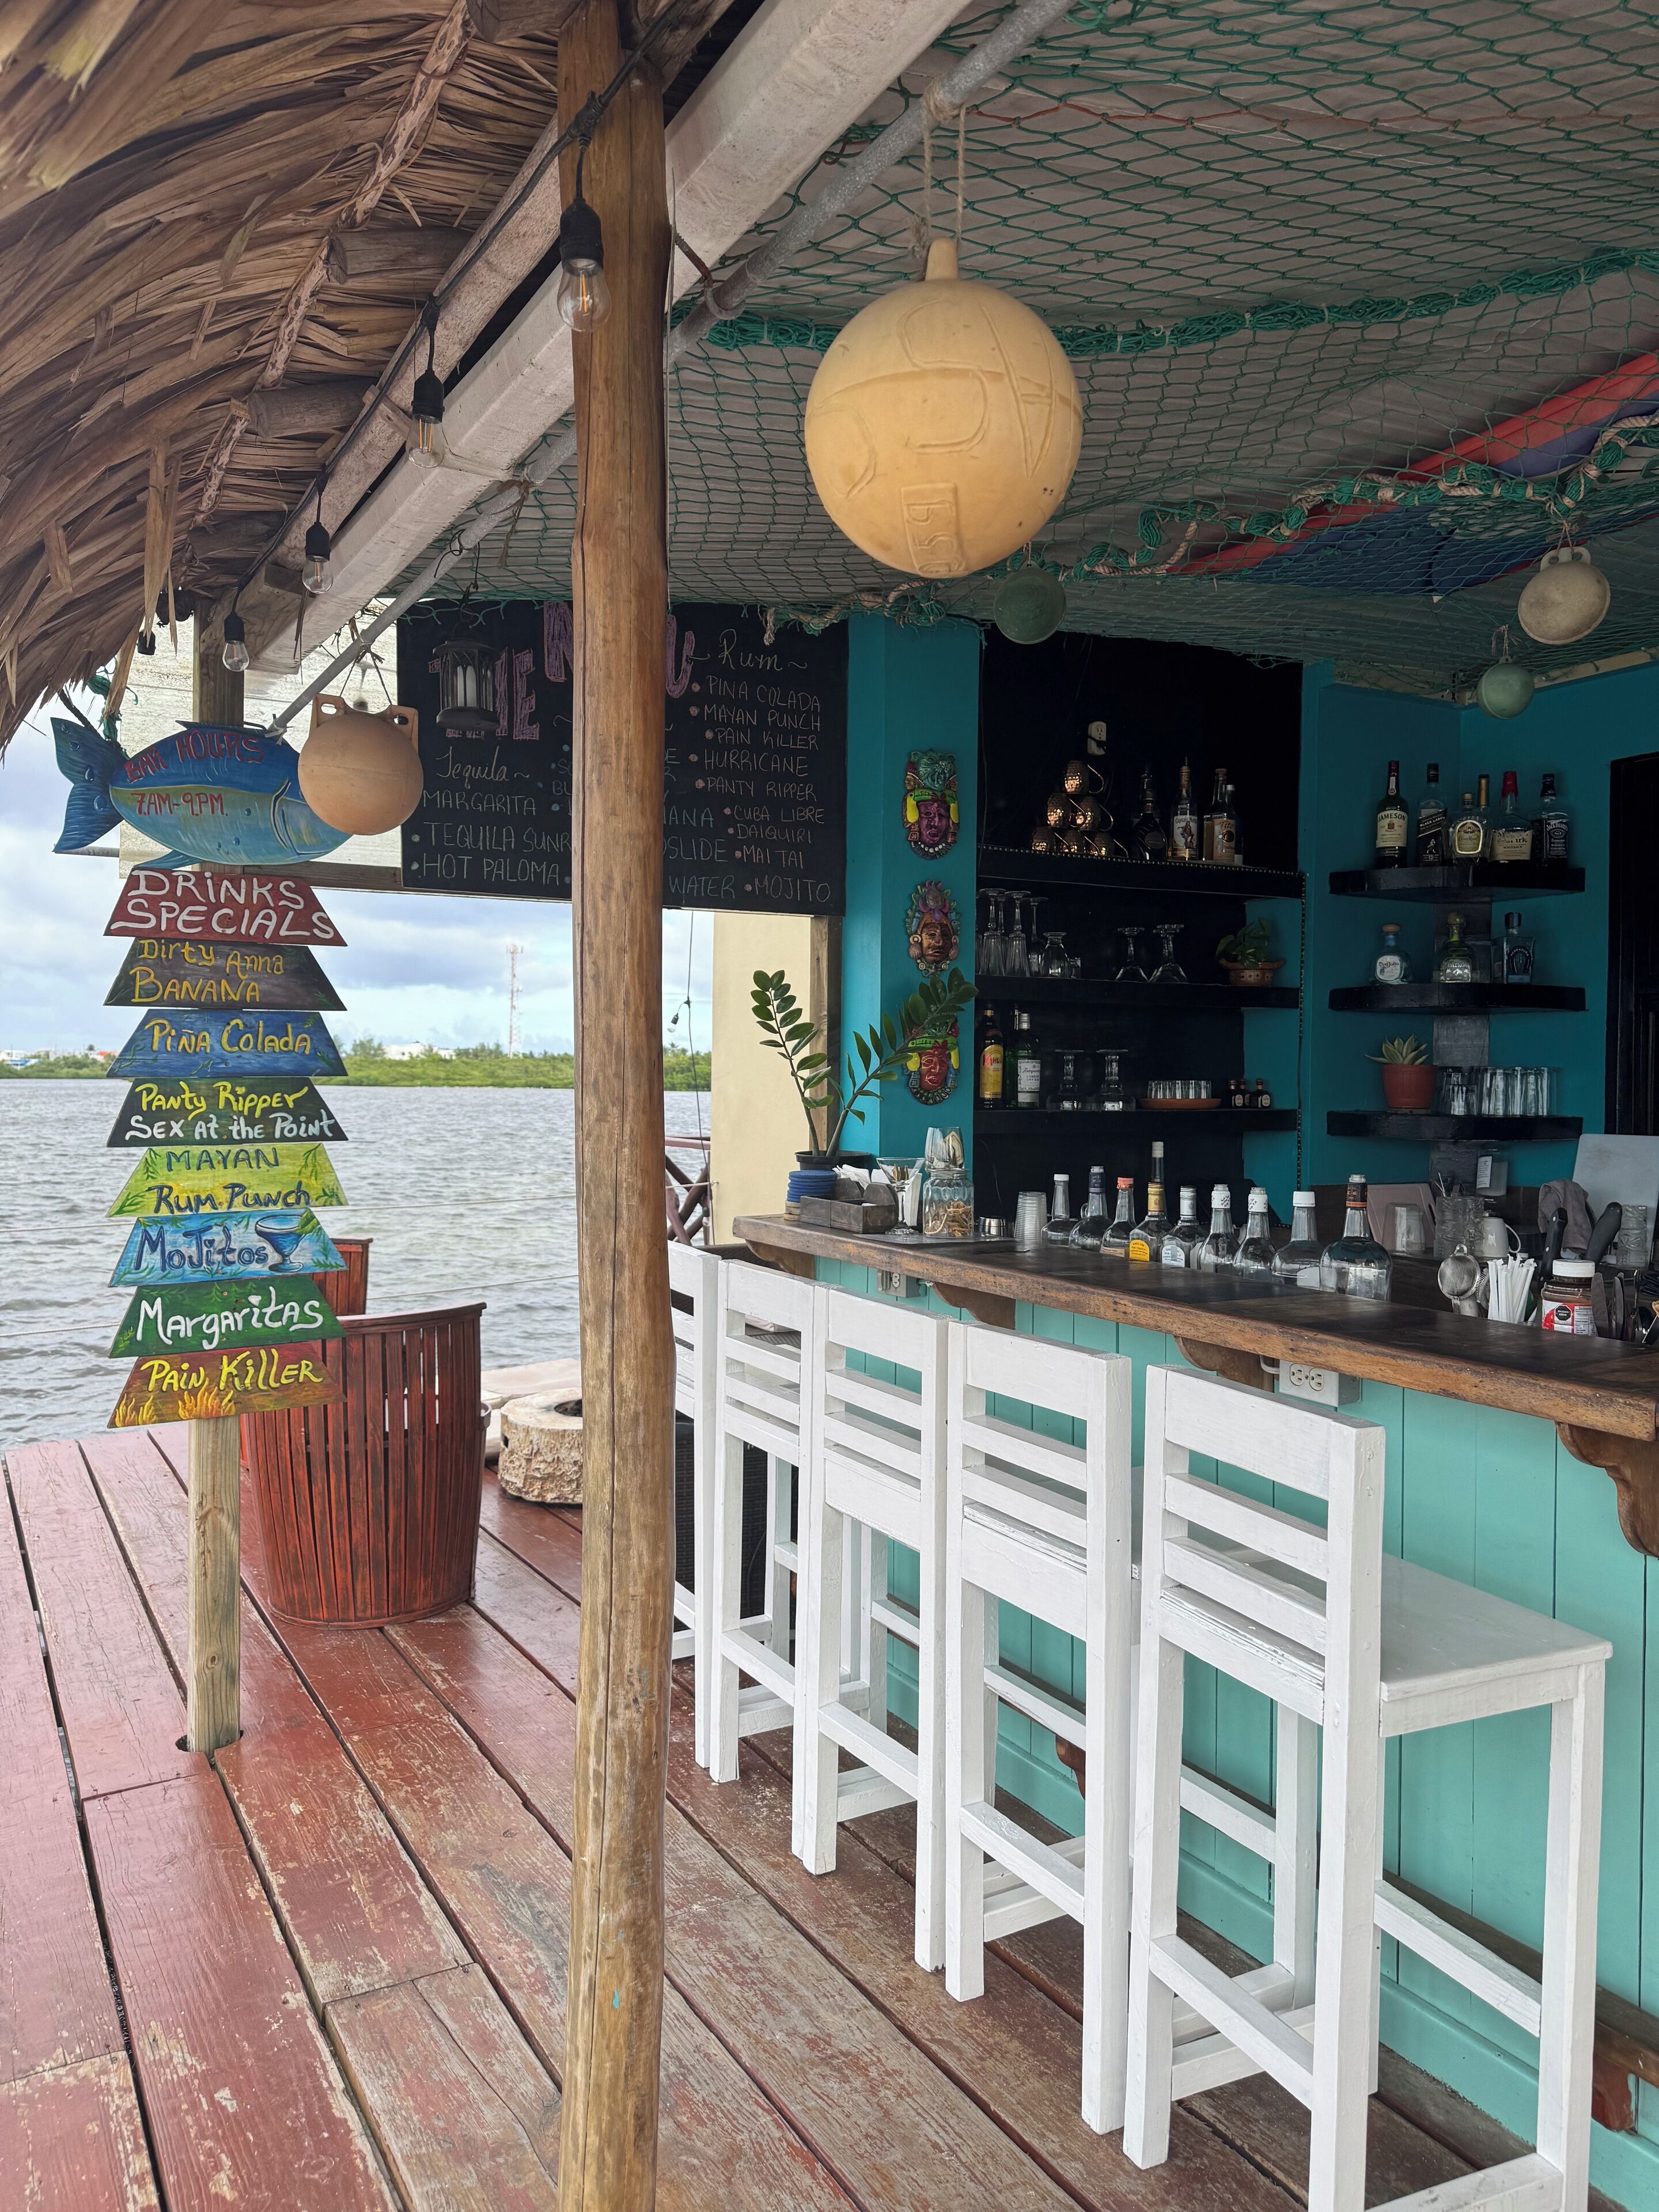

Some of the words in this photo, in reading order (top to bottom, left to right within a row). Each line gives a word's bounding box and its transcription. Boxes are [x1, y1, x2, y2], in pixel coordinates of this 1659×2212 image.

[718, 629, 782, 670] Rum
[706, 675, 748, 700] PINA
[756, 684, 820, 713] COLADA
[704, 704, 757, 725] MAYAN
[768, 709, 820, 732] PUNCH
[715, 727, 751, 745] PAIN
[763, 729, 818, 750] KILLER
[123, 746, 169, 783] BAR
[175, 729, 265, 764] HOURS
[435, 745, 510, 789] Tequila
[705, 748, 808, 777] HURRICANE
[707, 775, 754, 797] PANTY
[766, 781, 817, 801] RIPPER
[423, 789, 536, 816] MARGARITA
[733, 805, 770, 821] CUBA
[781, 806, 825, 824] LIBRE
[1378, 812, 1406, 822] JAMESON
[423, 821, 514, 851] TEQUILA
[737, 823, 812, 844] DAIQUIRI
[664, 836, 728, 862] SLIDE
[744, 844, 770, 863] MAI
[775, 850, 803, 869] TAI
[423, 853, 472, 879] HOT
[483, 857, 559, 885] PALOMA
[669, 875, 736, 899] WATER
[755, 875, 831, 902] MOJITO
[109, 898, 335, 939] SPECIALS
[138, 939, 215, 967] Dirty
[225, 950, 285, 980] Anna
[128, 965, 261, 1003] BANANA
[166, 1147, 280, 1172] MAYAN
